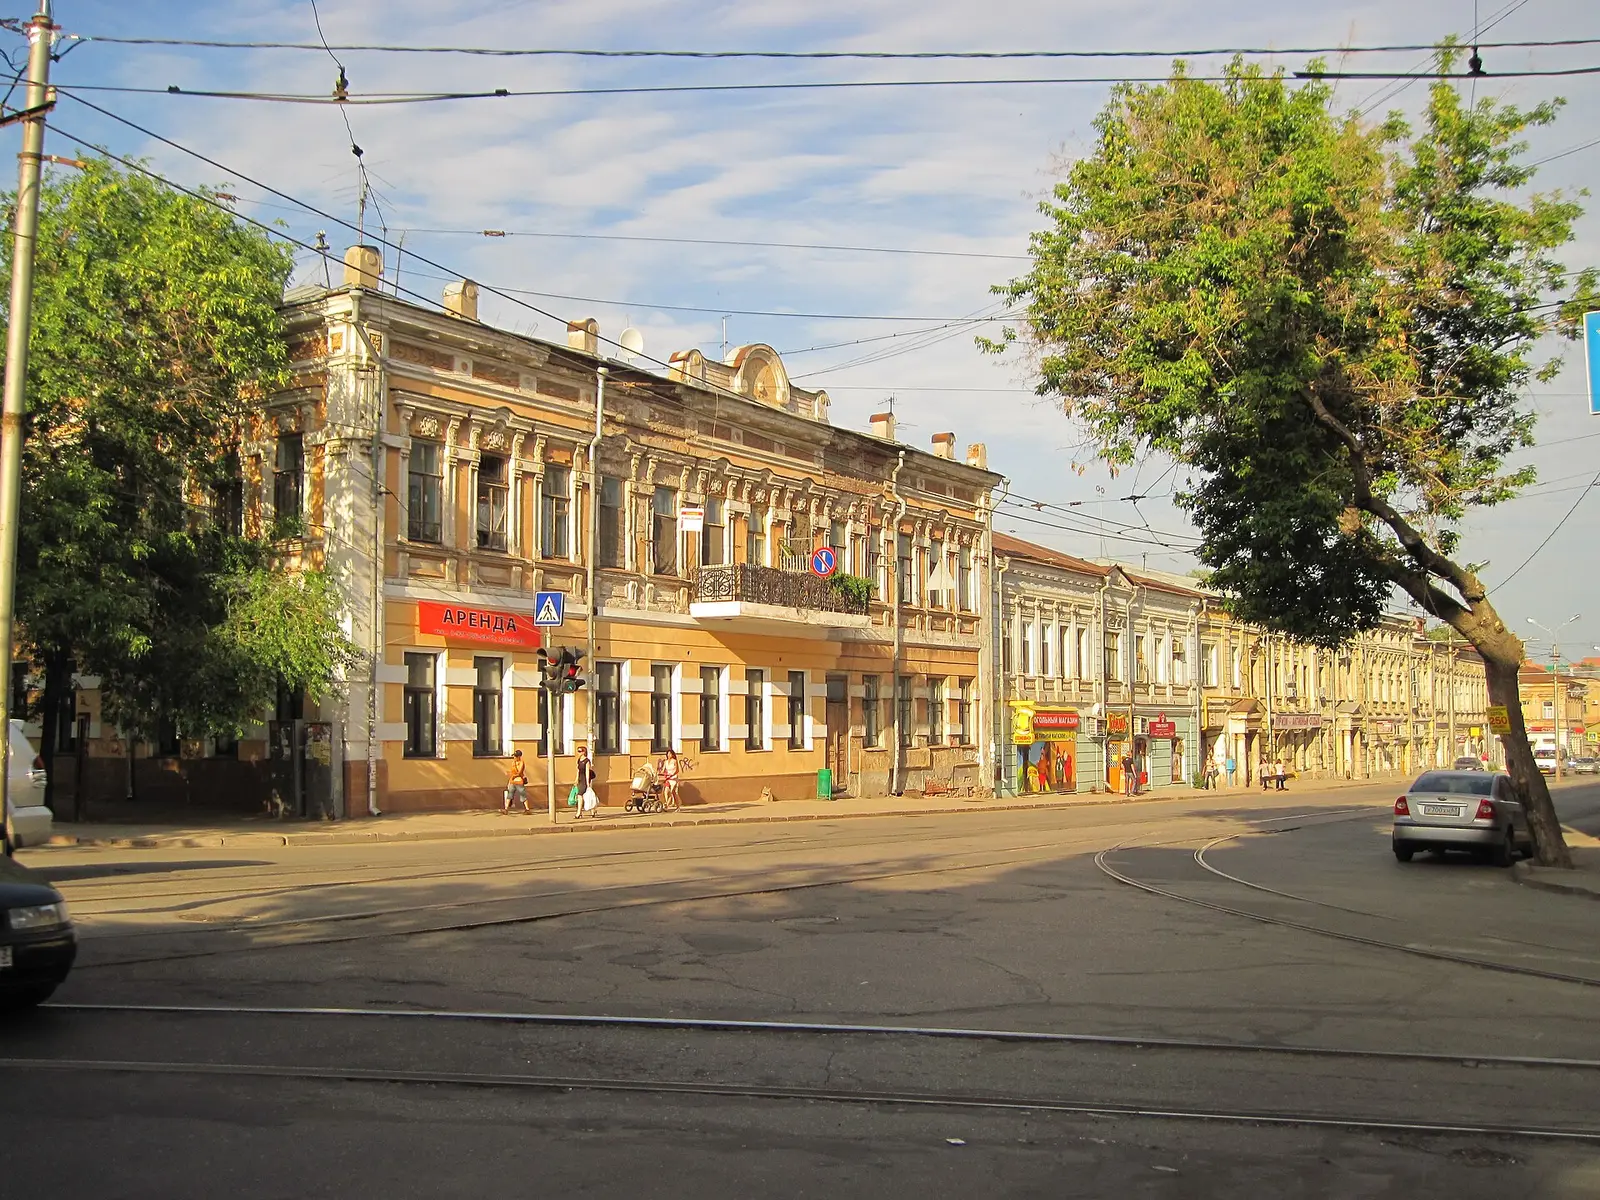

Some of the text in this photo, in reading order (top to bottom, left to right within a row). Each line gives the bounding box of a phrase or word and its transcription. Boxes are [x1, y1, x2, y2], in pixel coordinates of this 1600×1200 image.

[443, 609, 517, 633] АРЕНДА
[1033, 716, 1078, 724] ОГОЛЬНЫЙ МАГАЗИН
[1489, 716, 1508, 725] 250
